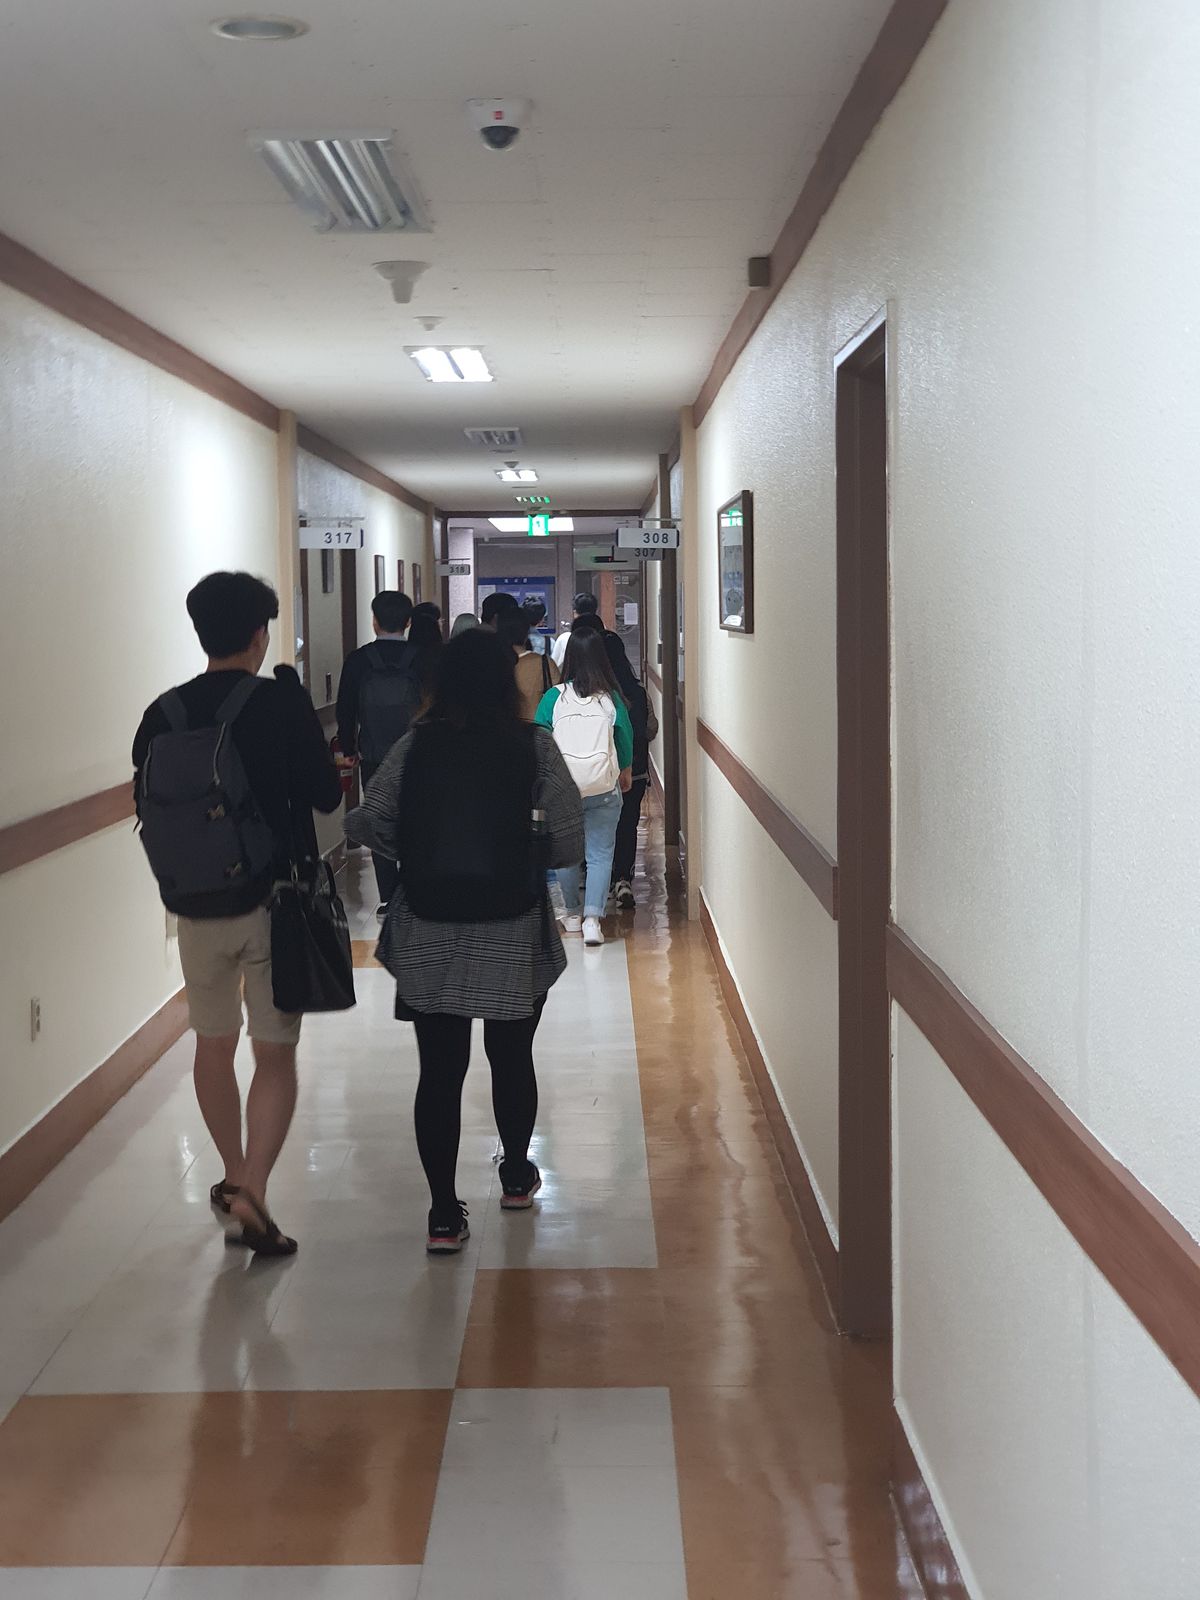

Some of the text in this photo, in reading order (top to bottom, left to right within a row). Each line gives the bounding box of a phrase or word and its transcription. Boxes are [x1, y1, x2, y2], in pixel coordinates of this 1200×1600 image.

[324, 532, 352, 544] 317
[643, 532, 669, 544] 308
[634, 547, 657, 557] 307
